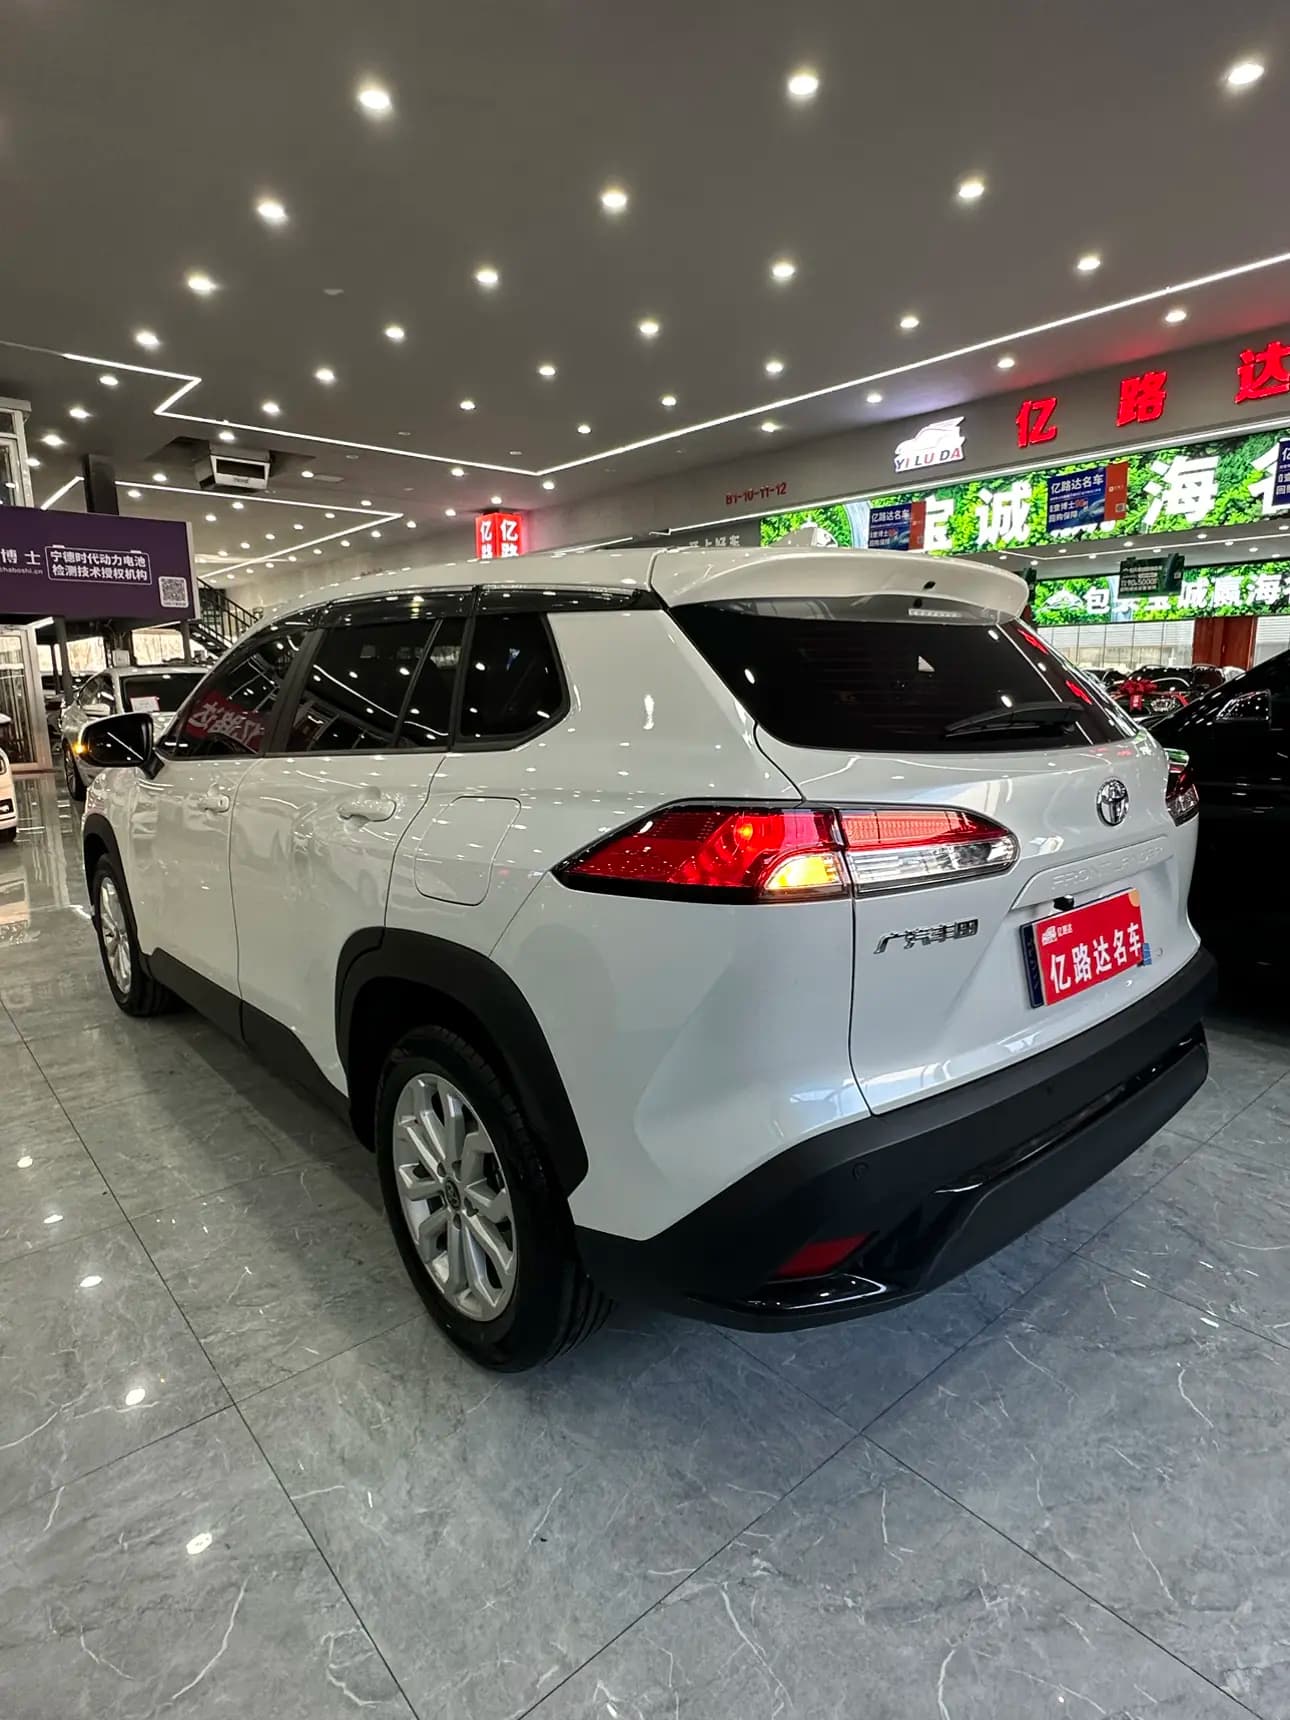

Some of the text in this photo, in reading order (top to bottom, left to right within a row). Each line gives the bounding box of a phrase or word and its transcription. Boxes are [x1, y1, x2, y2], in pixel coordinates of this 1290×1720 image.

[1050, 474, 1104, 495] 亿路达名车
[50, 550, 147, 568] 宁德时代动力电池
[52, 563, 148, 581] 检测技术授权机构
[873, 918, 979, 955] 广汽丰田
[1050, 922, 1141, 994] 亿路达名车
